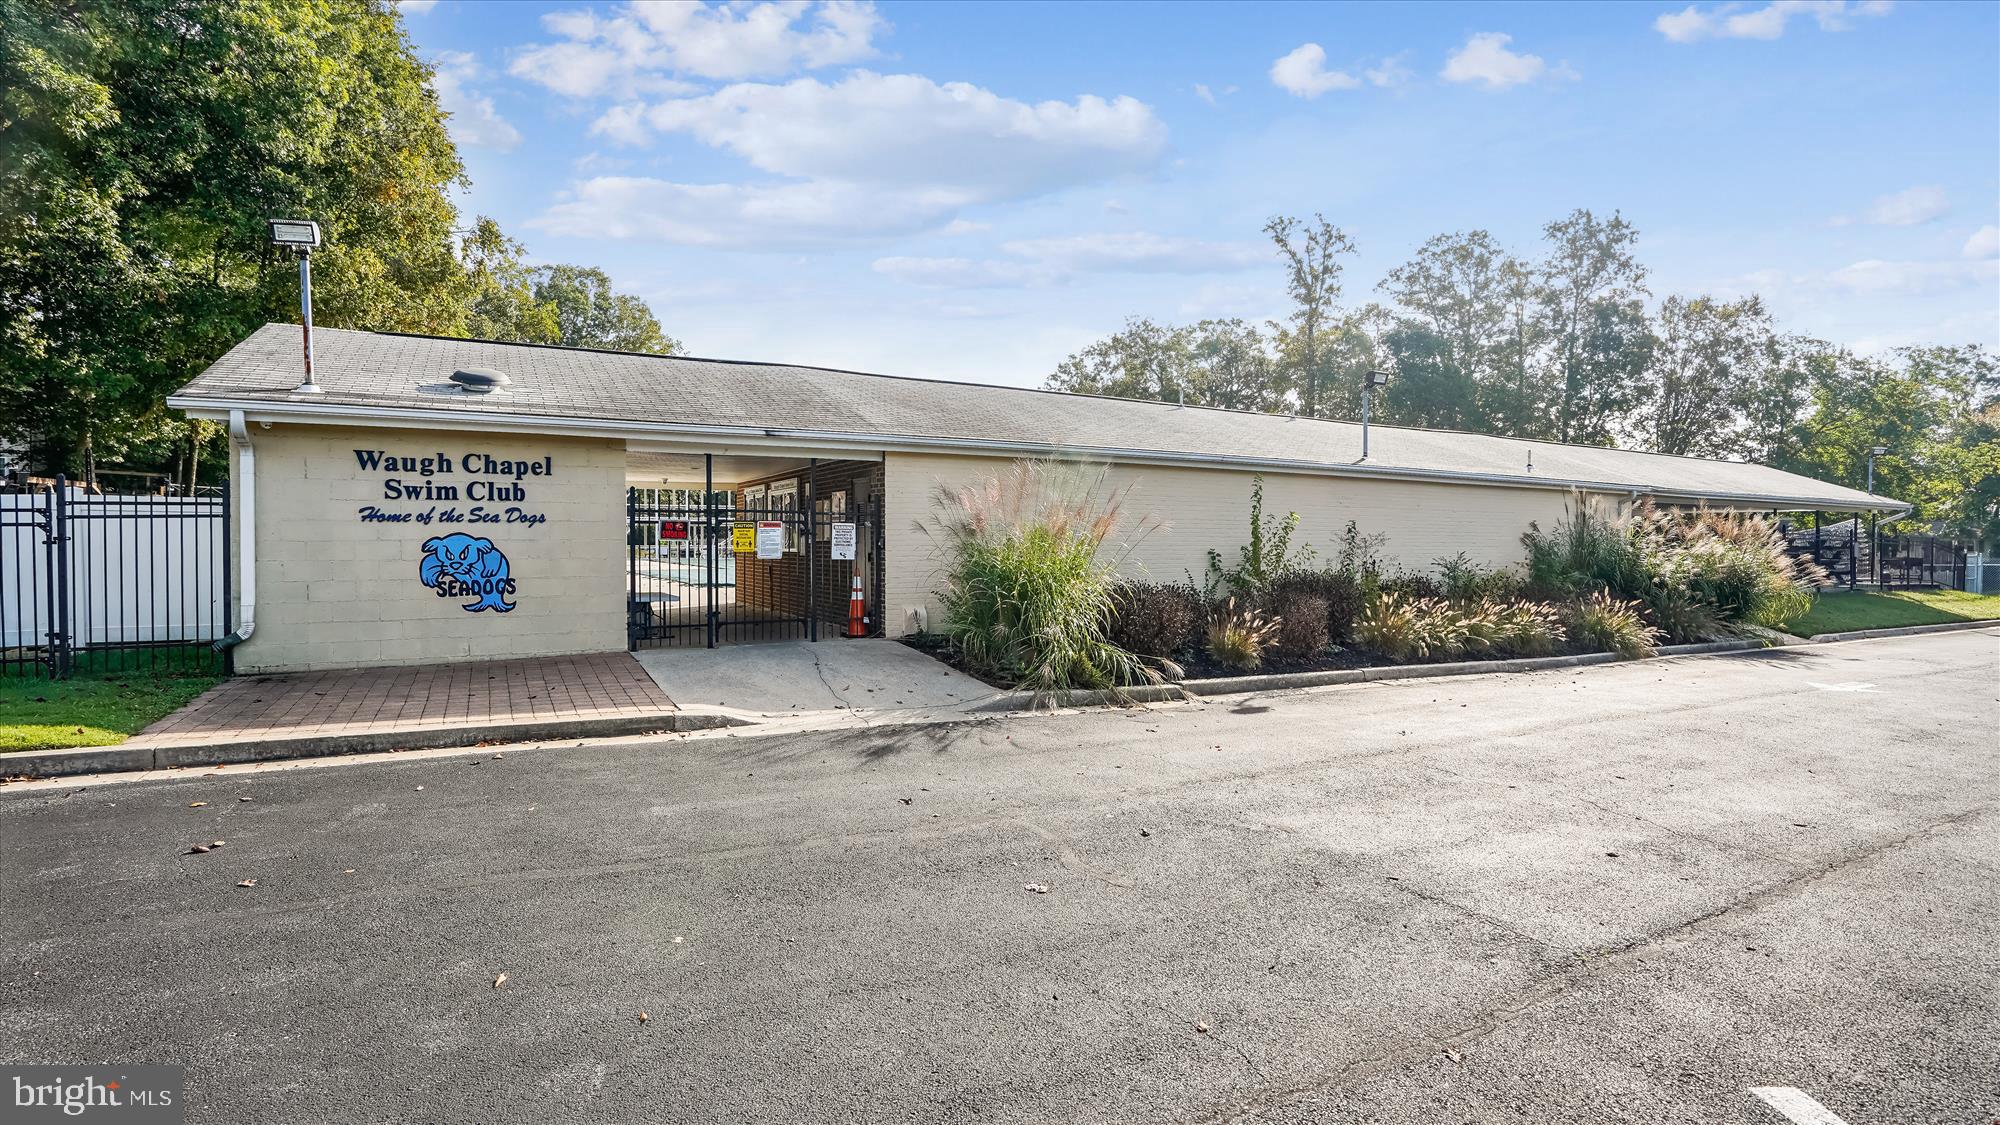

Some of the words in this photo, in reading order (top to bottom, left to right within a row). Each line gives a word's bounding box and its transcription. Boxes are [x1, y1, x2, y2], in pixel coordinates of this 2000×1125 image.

[353, 450, 453, 476] Waugh
[462, 453, 552, 480] Chapel
[384, 479, 459, 501] Swim
[466, 481, 526, 502] Club
[358, 506, 412, 523] Home
[416, 506, 436, 525] of
[438, 507, 465, 523] the
[468, 507, 501, 523] Sea
[505, 507, 547, 528] Dogs
[665, 522, 674, 530] NO
[662, 530, 687, 539] SMOKING
[436, 577, 517, 598] SEADOGS
